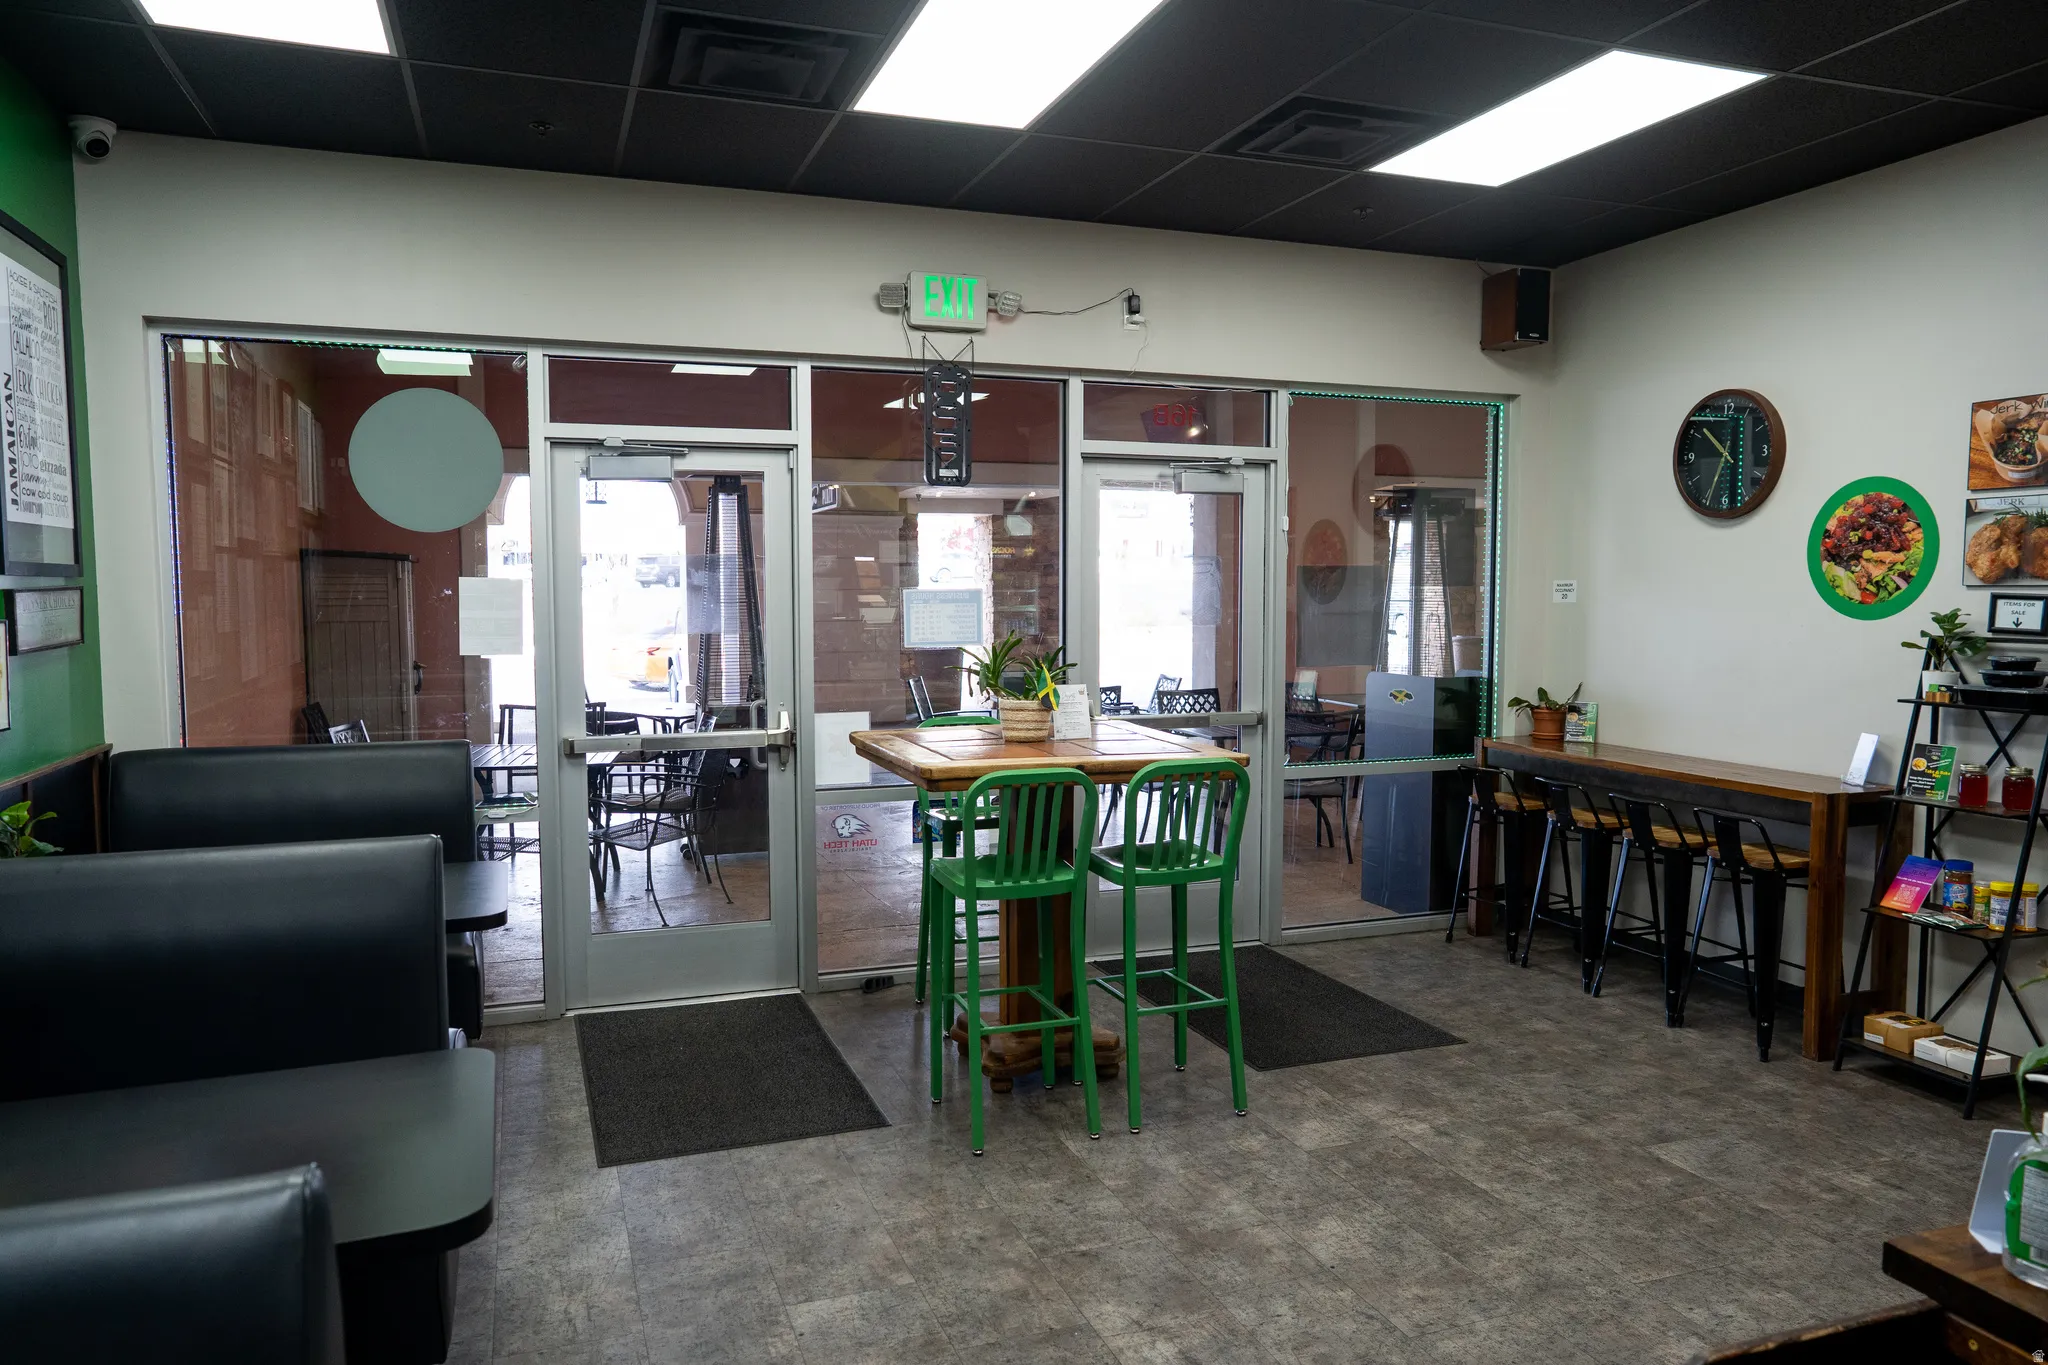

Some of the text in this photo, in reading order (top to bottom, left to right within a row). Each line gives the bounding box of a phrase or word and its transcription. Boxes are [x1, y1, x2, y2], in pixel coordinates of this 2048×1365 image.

[10, 269, 27, 287] ACKEE
[924, 275, 978, 320] EXIT
[43, 301, 58, 333] ROTI
[15, 368, 63, 406] JERK CHICKEN
[1724, 403, 1735, 414] 12
[1990, 401, 2023, 414] Jerk
[4, 372, 19, 511] JAMAICAN
[1762, 444, 1768, 456] 3
[1688, 452, 1695, 463] 9
[40, 459, 66, 477] gizzada
[22, 486, 68, 504] cow cod soup
[1722, 494, 1728, 505] 6
